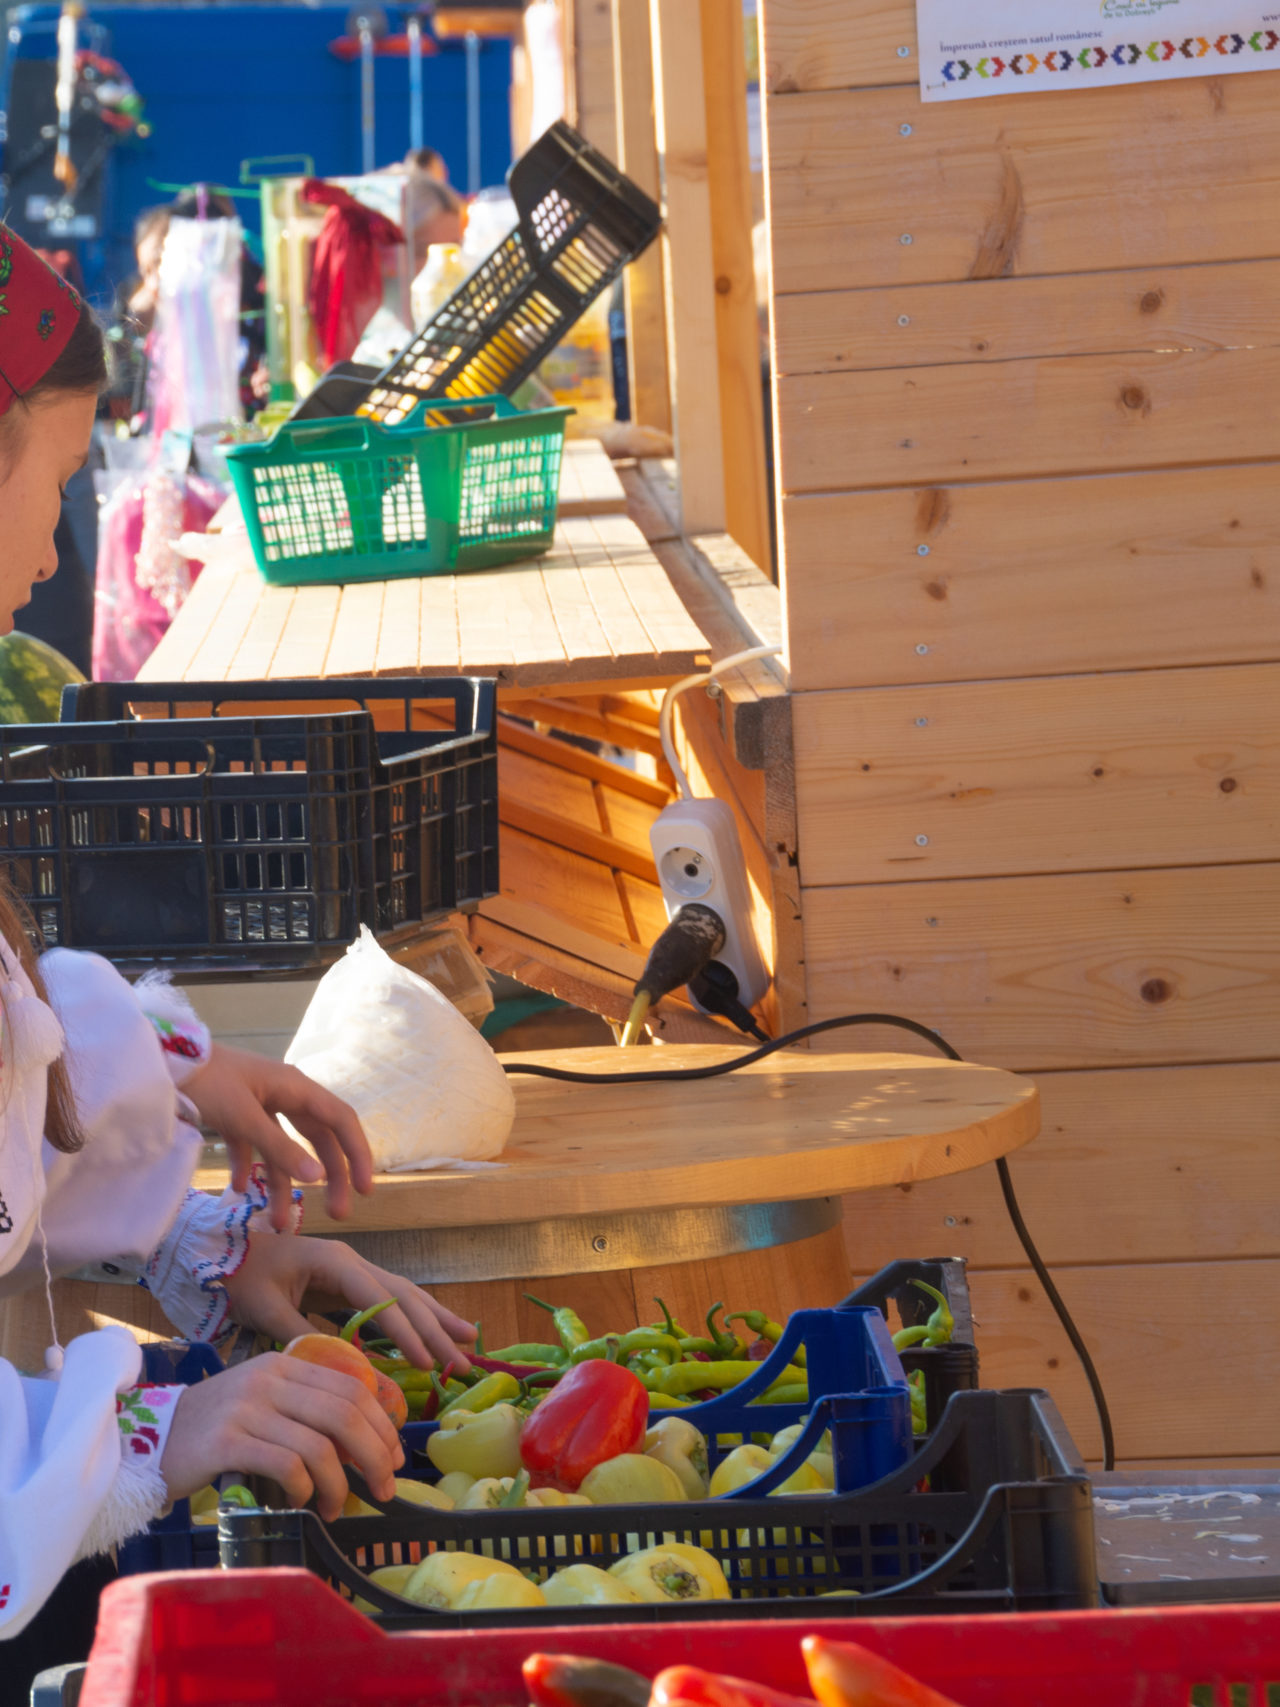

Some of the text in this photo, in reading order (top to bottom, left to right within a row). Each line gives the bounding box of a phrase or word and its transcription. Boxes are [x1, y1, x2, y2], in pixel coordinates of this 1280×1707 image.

[939, 30, 1103, 53] Împreună creștem satul românesc
